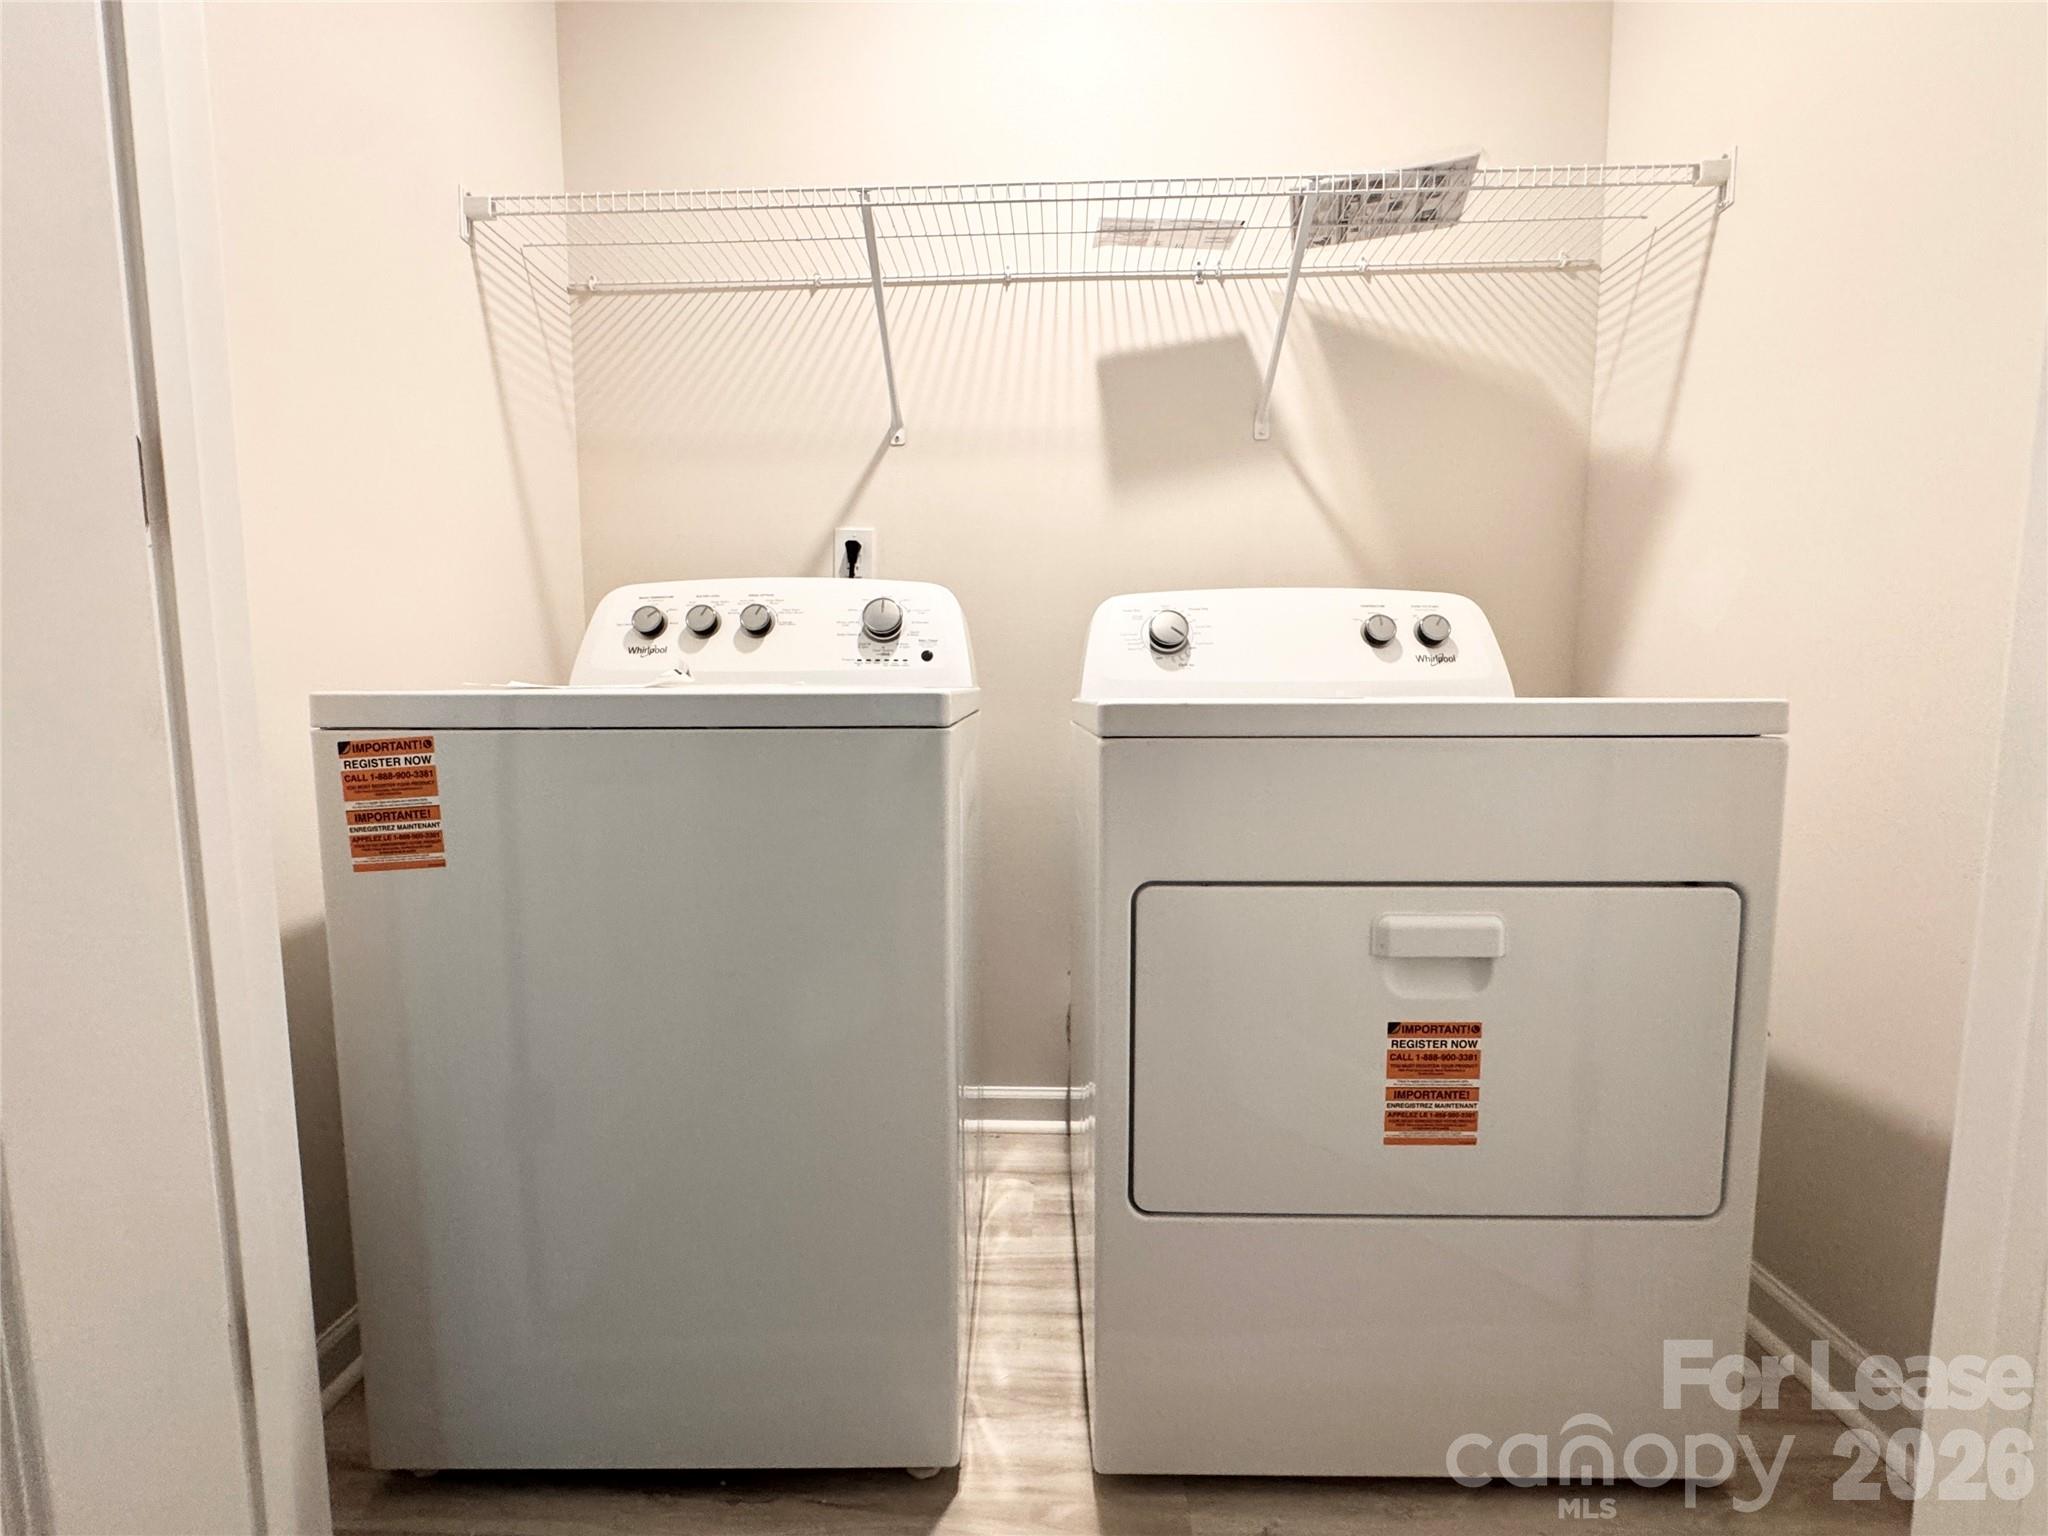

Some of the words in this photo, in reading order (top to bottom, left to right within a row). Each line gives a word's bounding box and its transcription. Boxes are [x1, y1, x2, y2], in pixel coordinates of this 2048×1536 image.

[628, 644, 668, 658] Whirlpool
[1416, 653, 1457, 667] Whirlpool
[352, 740, 422, 753] IMPORTANT!
[344, 757, 400, 769] REGISTER
[405, 756, 432, 765] NOW
[354, 810, 430, 822] IMPORTANTE!
[349, 825, 395, 833] ENREGISTREZ
[397, 822, 440, 830] MAINTENANT
[1402, 1025, 1470, 1034] IMPORTANT!
[1391, 1040, 1447, 1048] REGISTER
[1451, 1040, 1478, 1048] NOW
[1394, 1091, 1469, 1099] IMPORTANTE!
